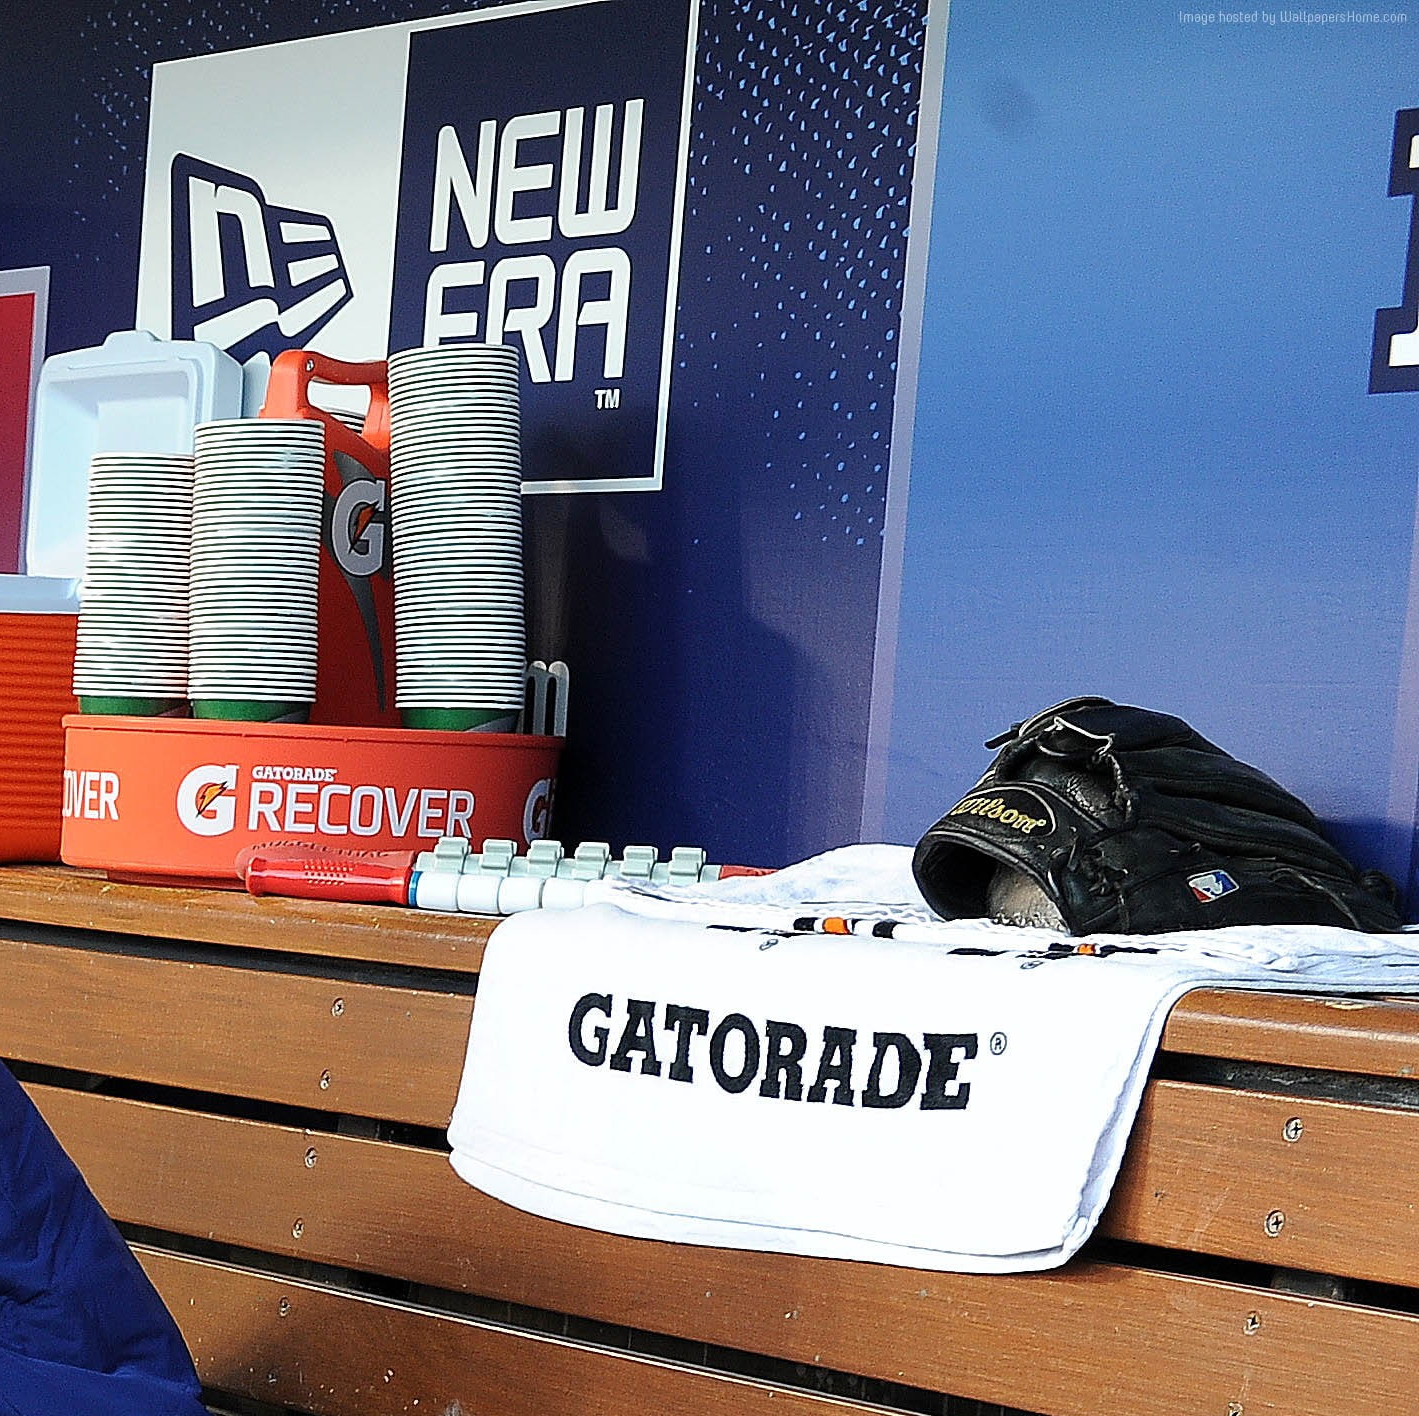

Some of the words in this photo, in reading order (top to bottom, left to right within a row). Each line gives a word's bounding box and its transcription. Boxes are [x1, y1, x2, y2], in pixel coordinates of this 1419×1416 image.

[429, 98, 644, 252] NEW
[423, 247, 631, 383] ERA
[331, 479, 386, 577] G
[176, 763, 239, 838] G
[248, 781, 476, 839] RECOVER
[252, 766, 335, 782] GATORADE
[568, 992, 980, 1112] GATORADE
